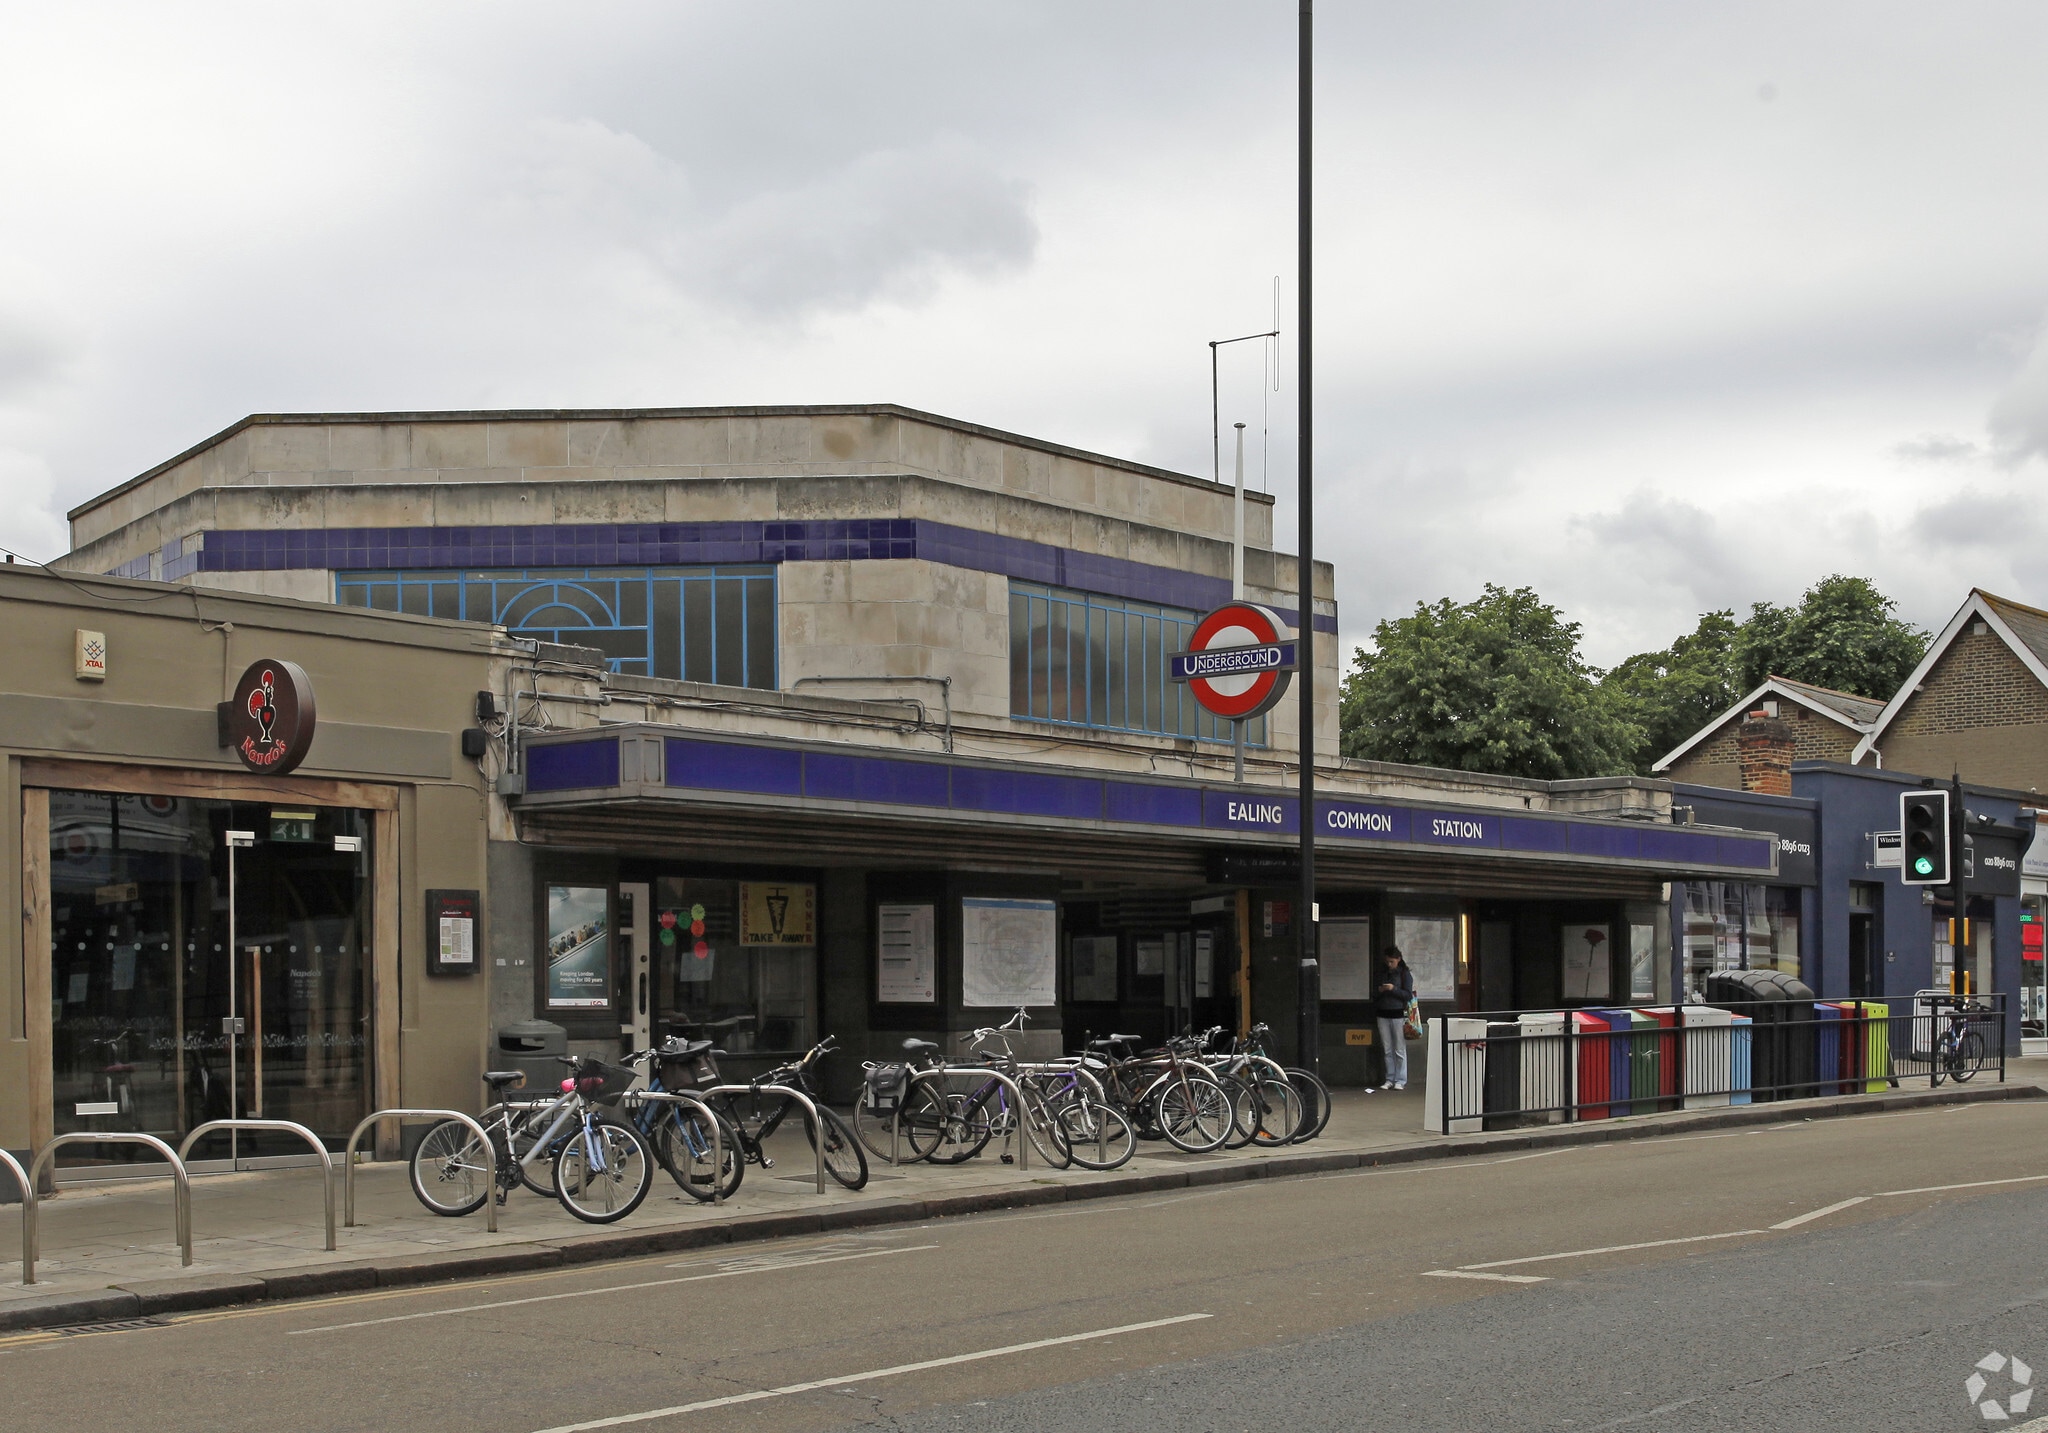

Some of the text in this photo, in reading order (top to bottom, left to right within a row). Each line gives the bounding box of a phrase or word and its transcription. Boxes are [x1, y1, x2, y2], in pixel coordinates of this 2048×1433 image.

[85, 660, 104, 669] XTAL
[1183, 647, 1282, 675] UNDERGROUND
[241, 736, 287, 765] Nando's
[1228, 801, 1483, 839] EALING COMMON STATION
[1781, 839, 1797, 854] 8896
[805, 888, 813, 944] DONER
[749, 933, 805, 943] TAKE AWAY
[1352, 1033, 1366, 1041] RVP
